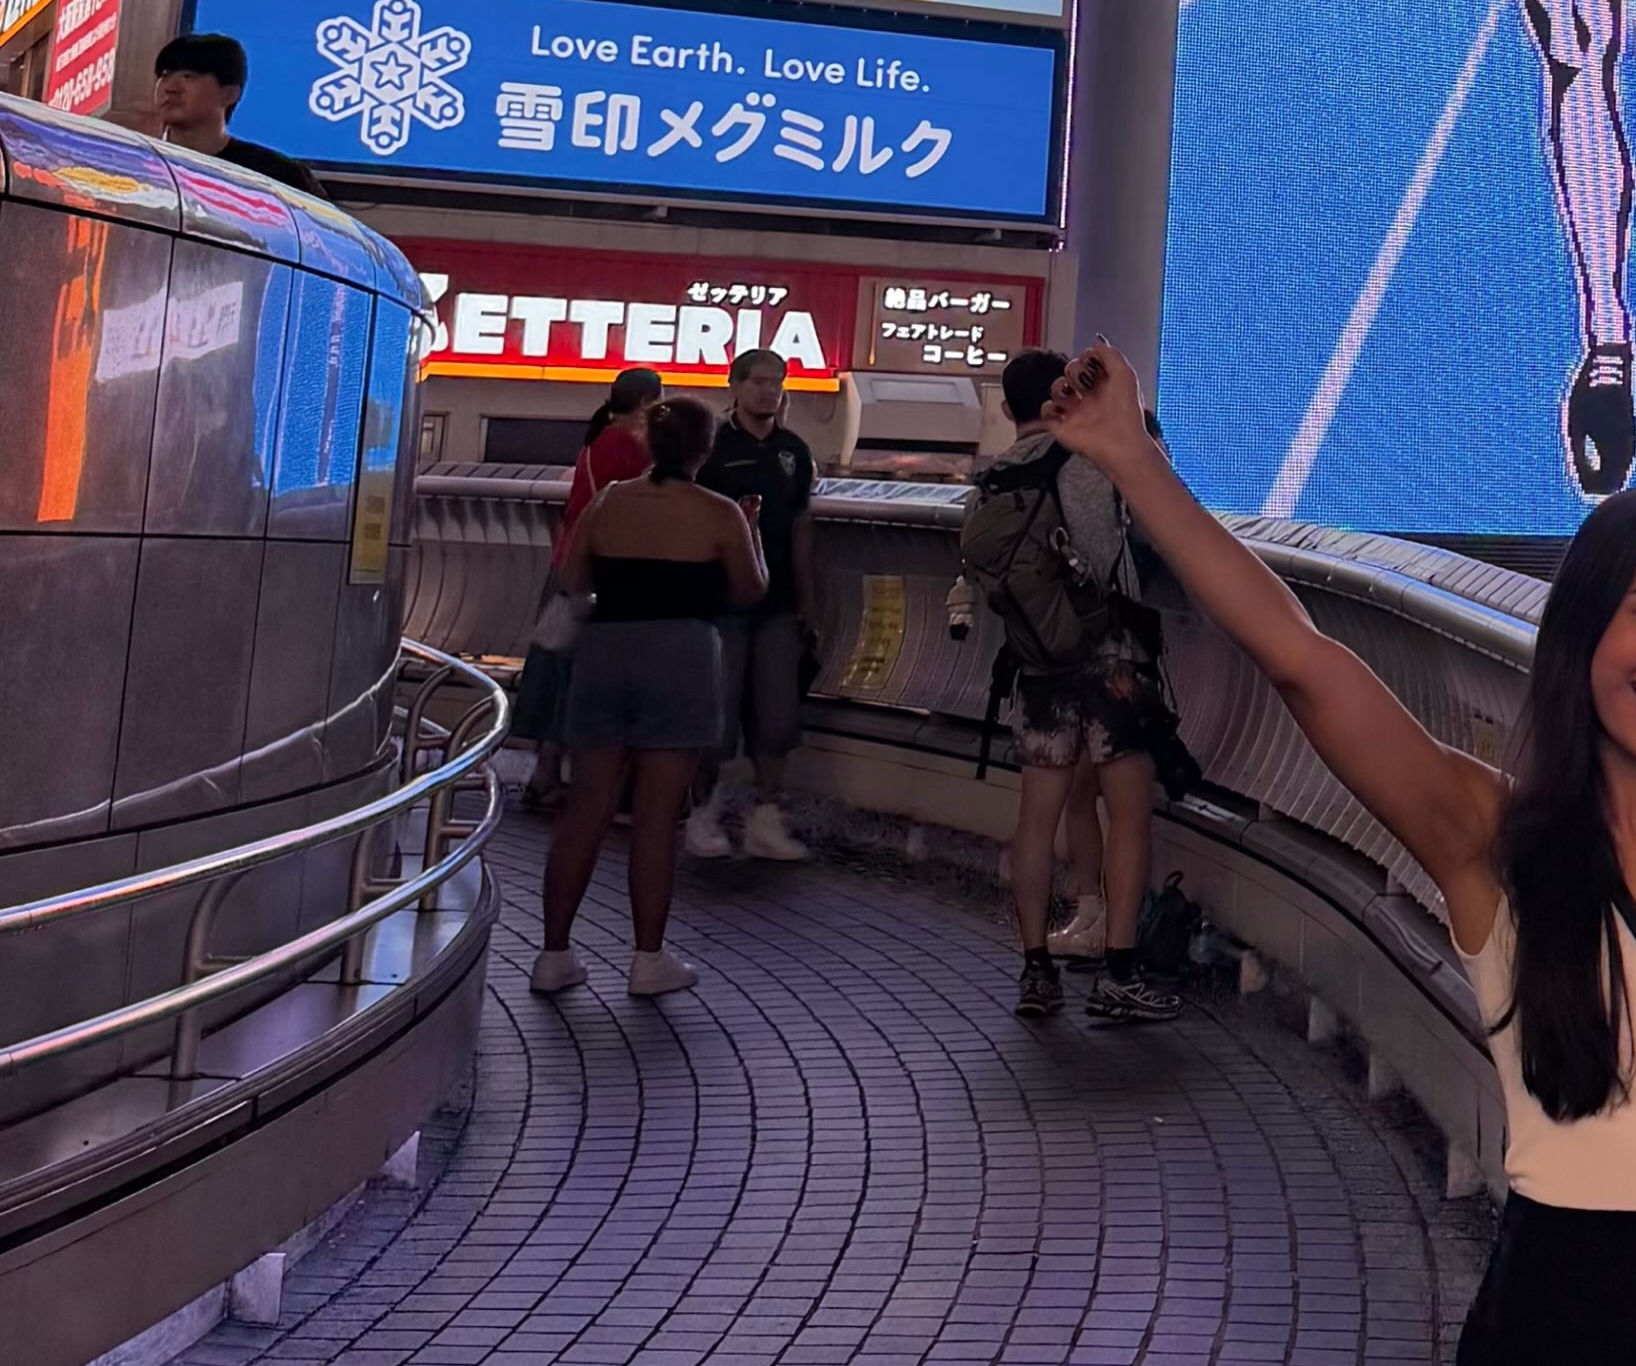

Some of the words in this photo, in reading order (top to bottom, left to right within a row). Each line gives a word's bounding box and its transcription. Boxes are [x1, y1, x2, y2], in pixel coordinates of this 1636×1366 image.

[531, 25, 619, 62] Love
[630, 35, 746, 75] Earth.
[764, 49, 846, 83] Love
[856, 58, 931, 93] Life.
[495, 81, 953, 178] 雪印メグミルク
[687, 282, 788, 306] ゼッテリア
[884, 287, 1011, 314] 絶品バーガー
[881, 322, 984, 343] フェアトレード
[922, 344, 1008, 366] コーヒー
